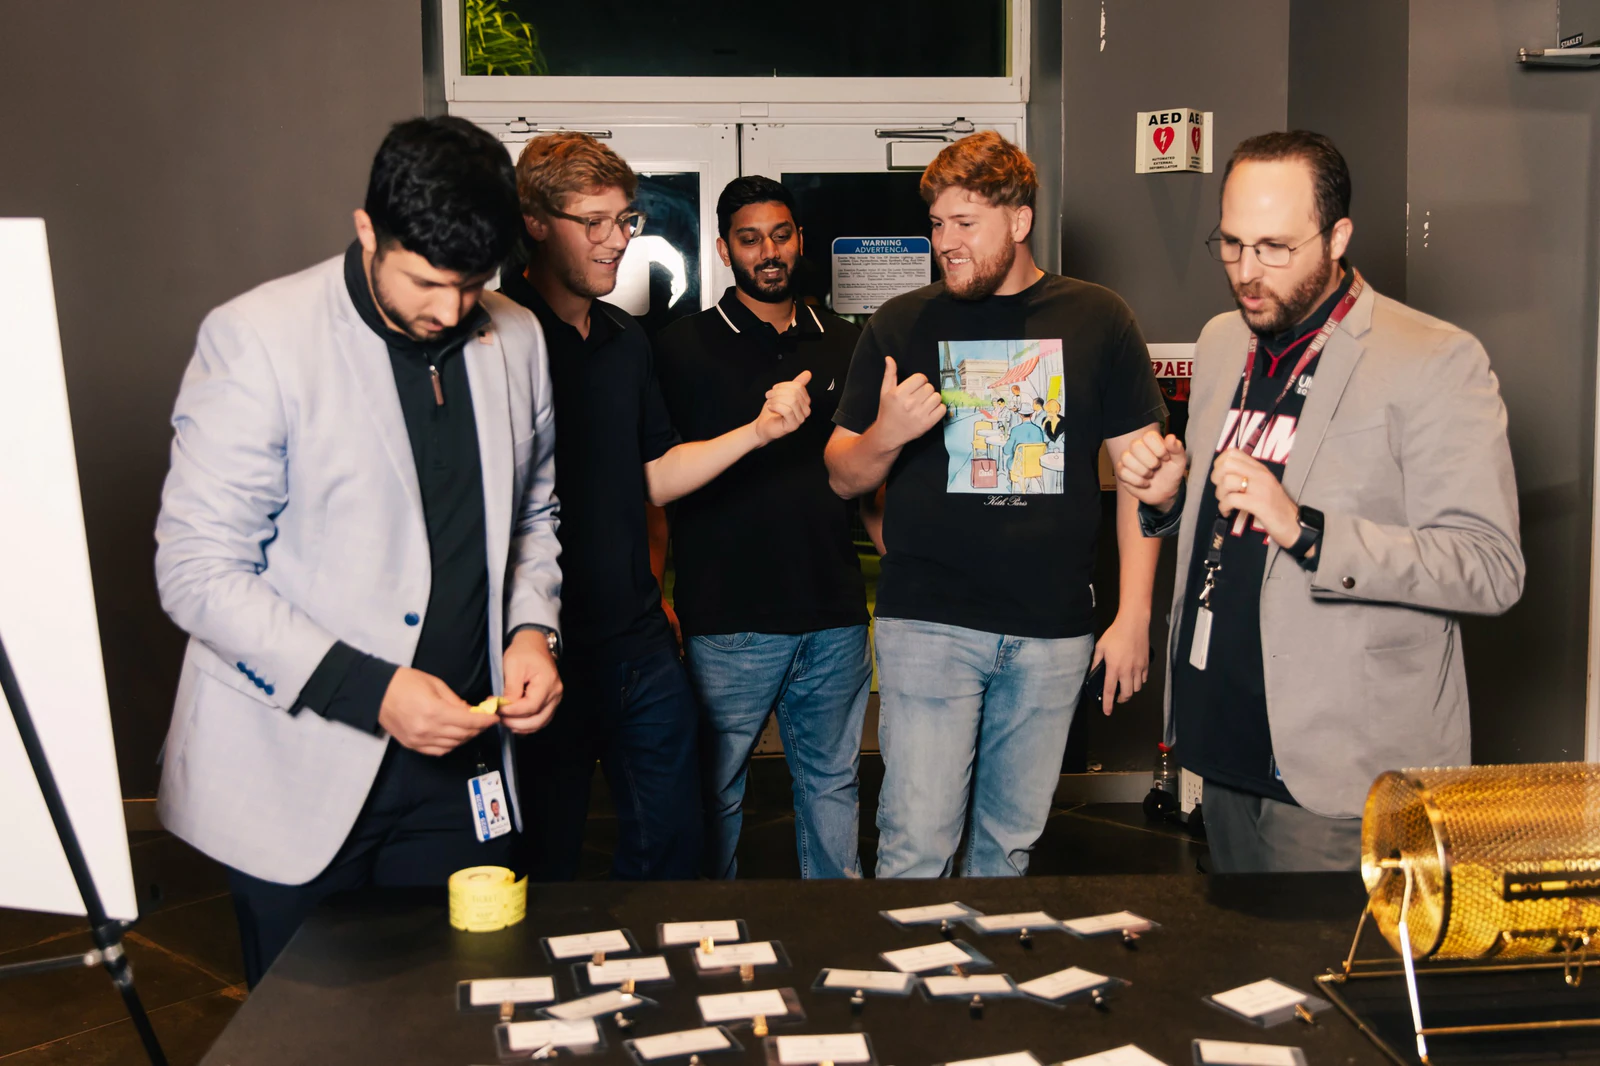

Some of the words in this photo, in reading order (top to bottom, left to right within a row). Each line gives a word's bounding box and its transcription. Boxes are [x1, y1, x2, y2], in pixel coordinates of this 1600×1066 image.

[1148, 112, 1182, 126] AED
[983, 494, 1009, 506] Kith
[1007, 494, 1028, 506] Paris
